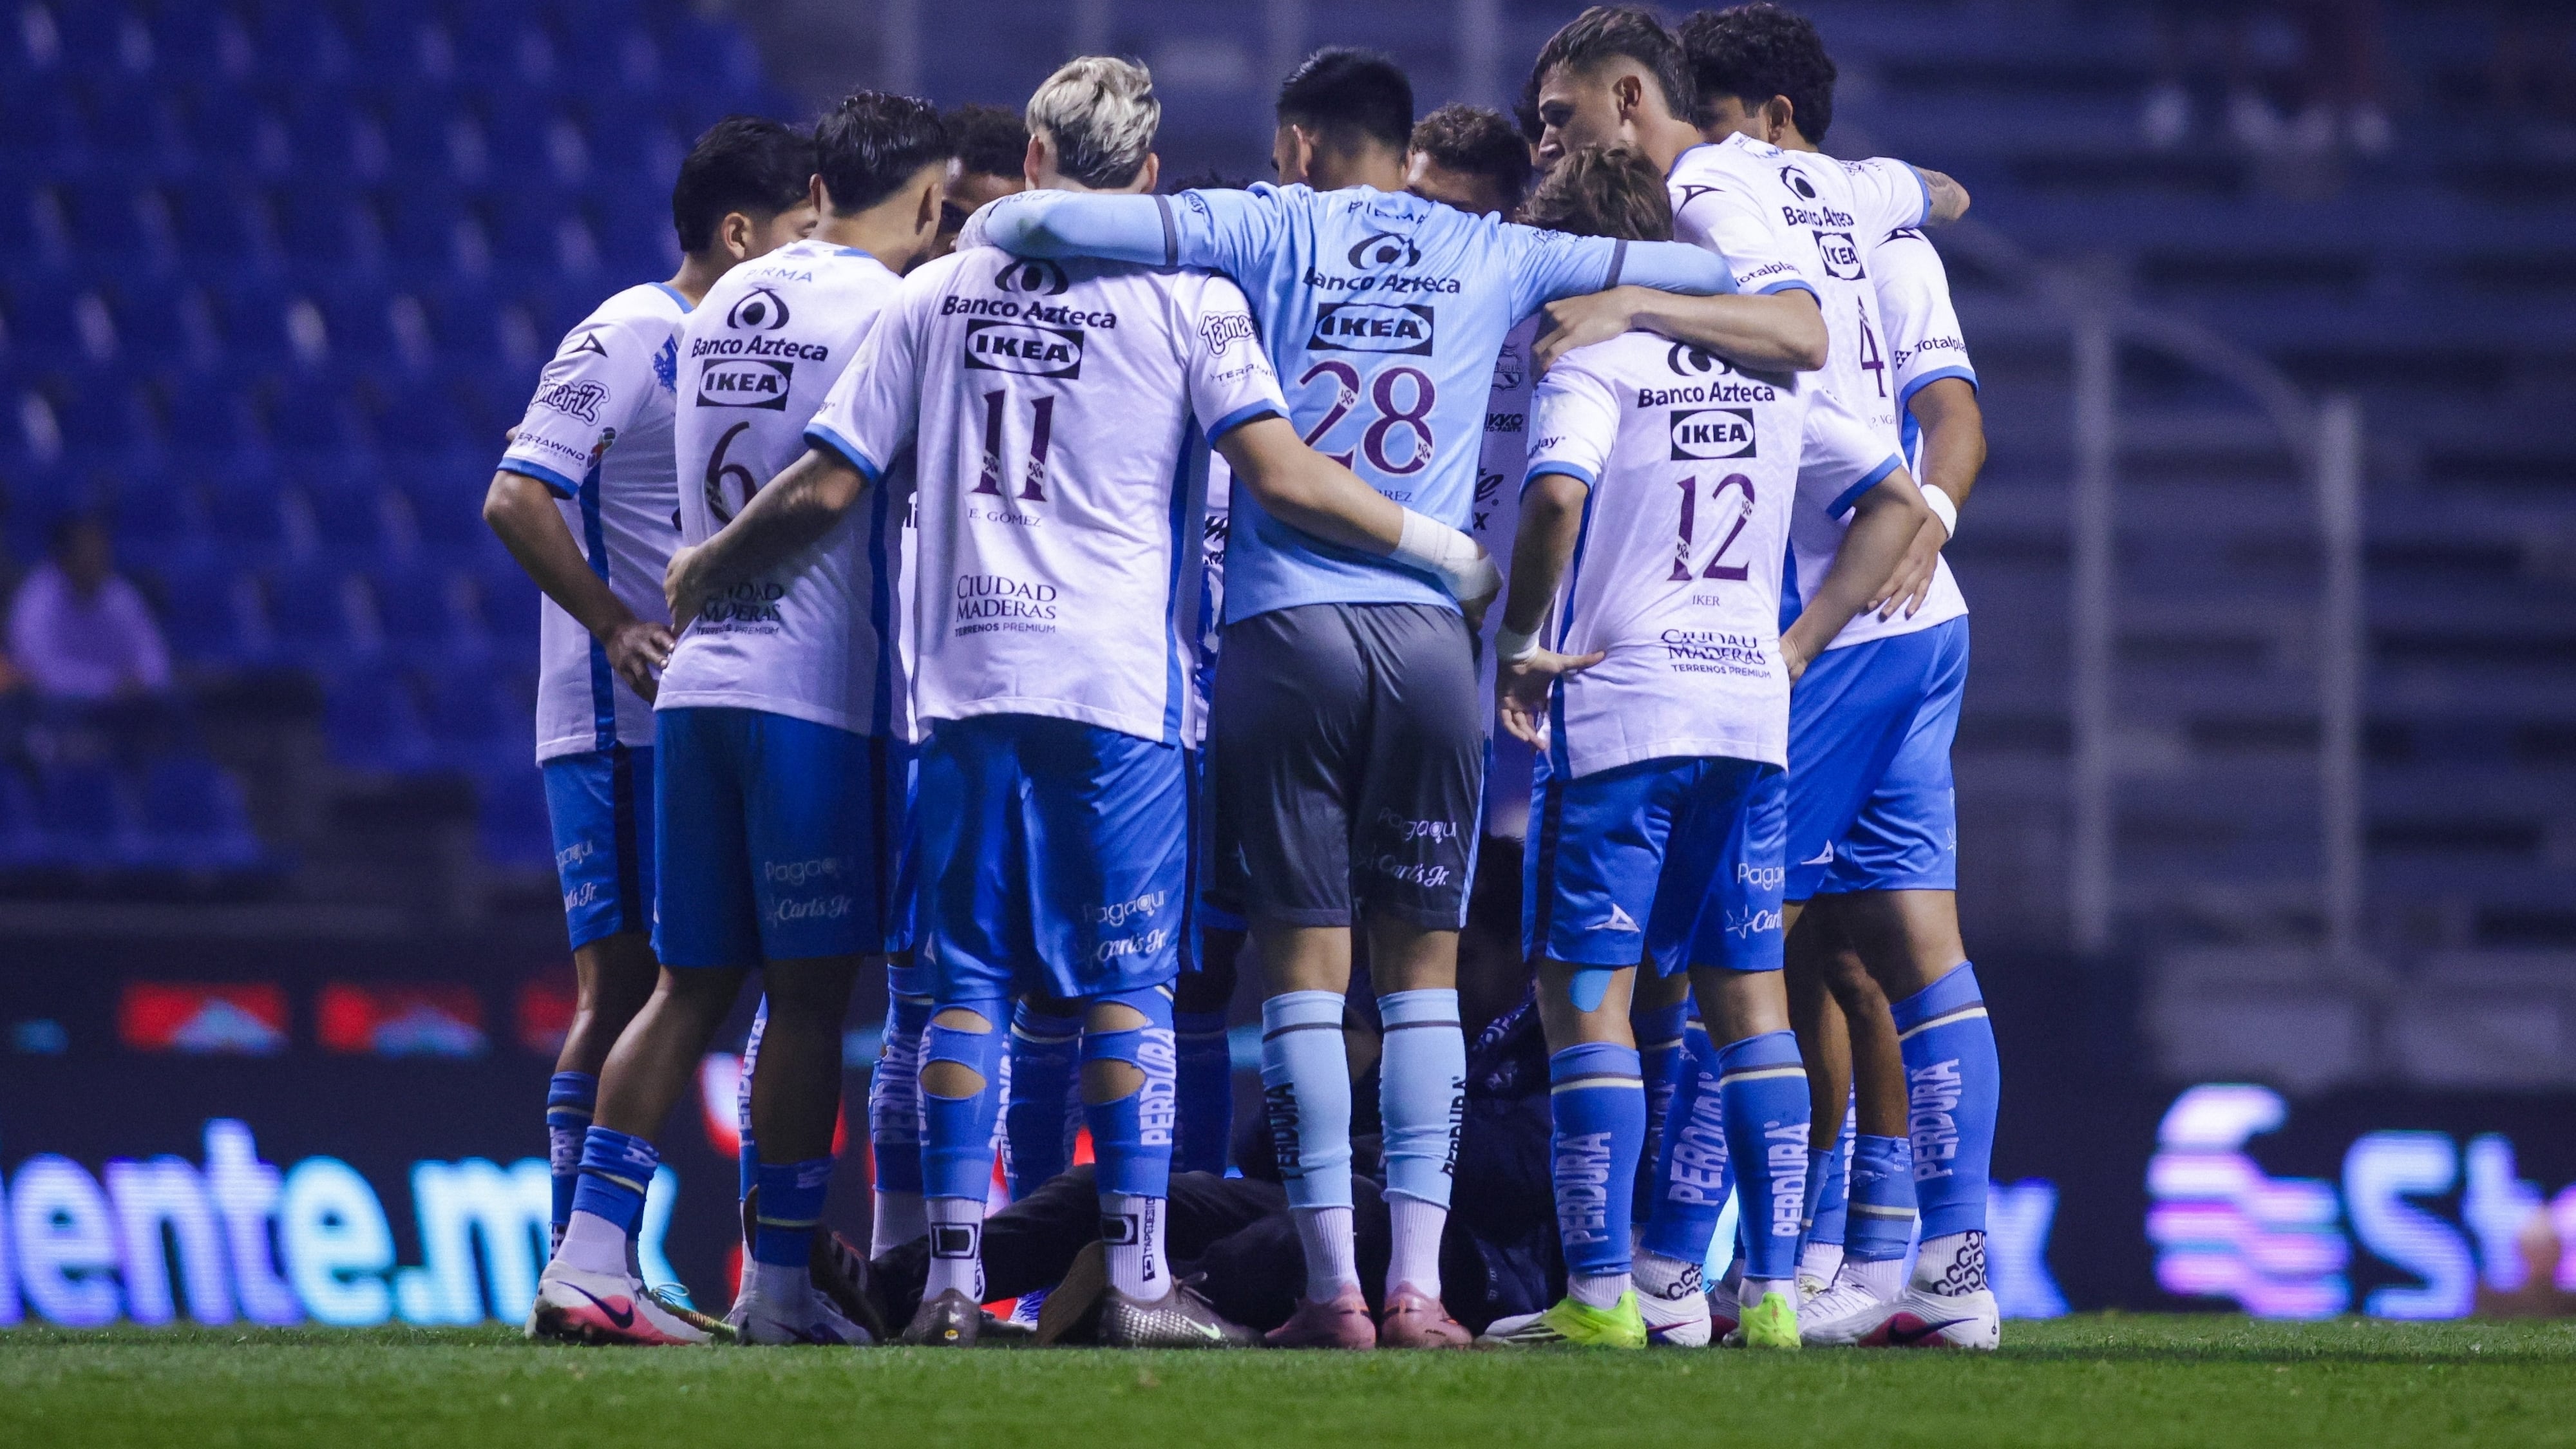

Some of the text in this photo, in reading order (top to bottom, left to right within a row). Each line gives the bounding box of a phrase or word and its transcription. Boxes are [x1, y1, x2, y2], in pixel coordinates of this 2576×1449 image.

[1823, 245, 1859, 265] IKEA
[1378, 273, 1461, 294] Azteca
[941, 295, 1117, 329] Banco Azteca
[1200, 314, 1255, 355] Tama
[1320, 316, 1423, 339] IKEA
[691, 335, 829, 362] Banco Azteca
[976, 334, 1070, 363] IKEA
[1857, 295, 1888, 397] 4
[705, 372, 779, 394] IKEA
[1637, 381, 1776, 408] Banco Azteca
[1299, 360, 1436, 475] 28
[518, 432, 585, 461] ERRAWIND
[970, 388, 1055, 502] 11
[1681, 424, 1748, 444] IKEA
[706, 421, 759, 524] 6
[969, 508, 981, 519] E.
[1666, 473, 1756, 582] 12
[957, 574, 1057, 602] CIUDAD
[1692, 594, 1720, 607] IKER
[956, 598, 1057, 623] MADERAS
[955, 622, 1056, 638] TERRENOS PREMIUM
[1671, 663, 1772, 679] TERRENOS PREMIUM
[1423, 865, 1450, 887] Jr.
[1083, 890, 1165, 928] agaqui
[1138, 1027, 1177, 1147] PERDURA
[1909, 1058, 1962, 1182] PERDURA
[1555, 1131, 1612, 1245] PERDURA
[1763, 1122, 1812, 1237] PERDURA
